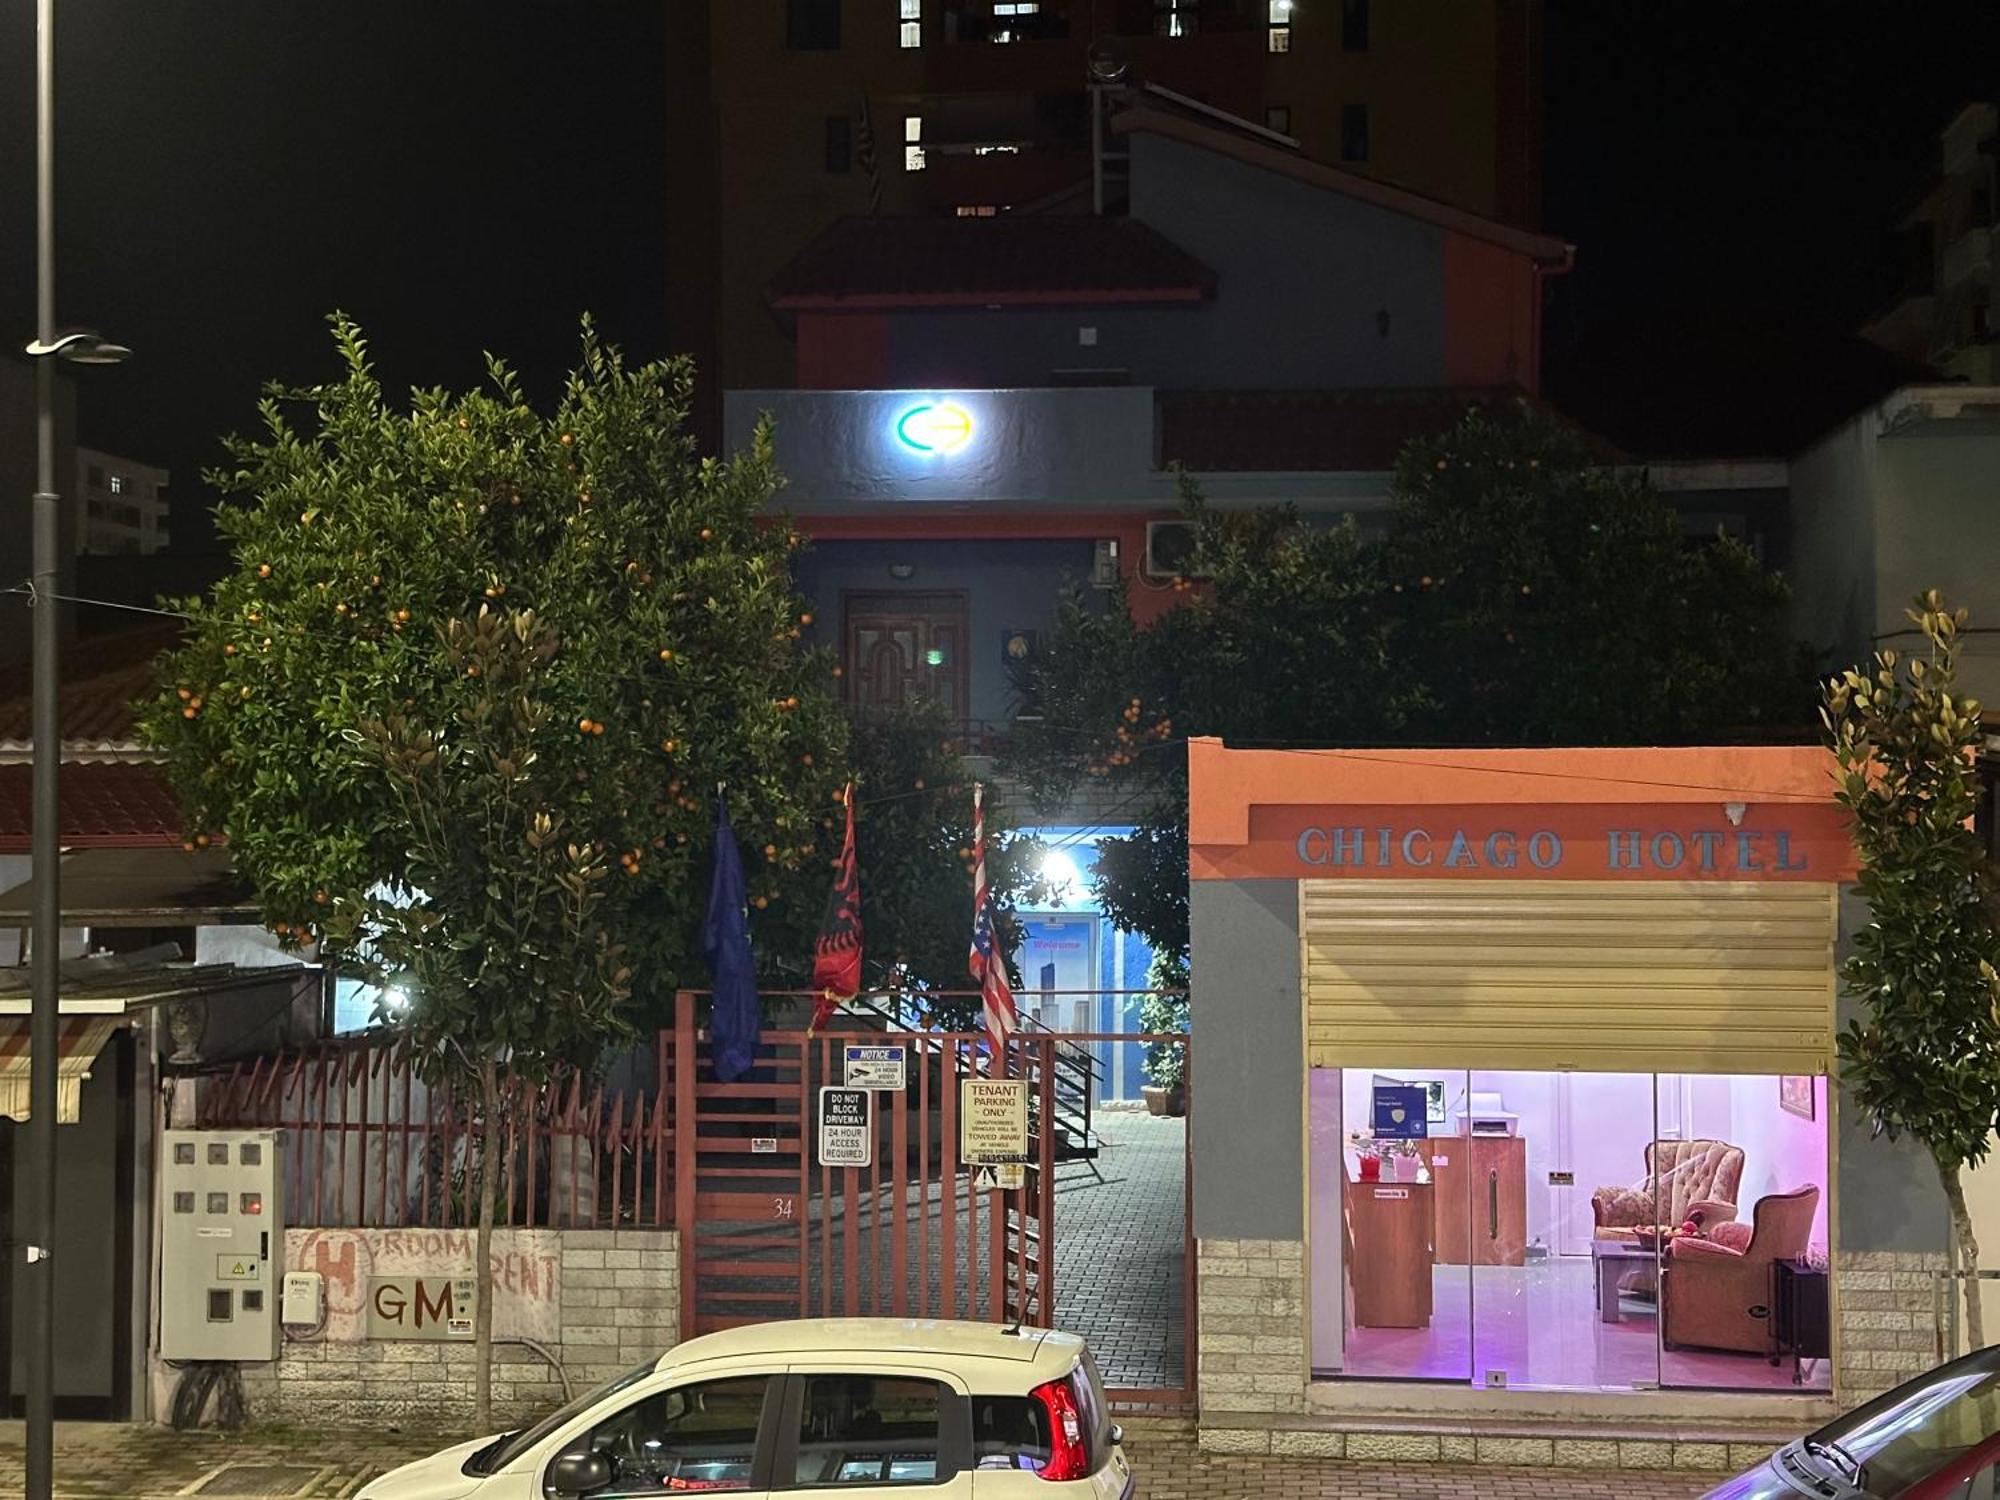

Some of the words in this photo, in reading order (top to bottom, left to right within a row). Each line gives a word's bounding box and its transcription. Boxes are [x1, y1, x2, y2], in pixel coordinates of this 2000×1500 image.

[1297, 826, 1563, 868] CHICAGO
[1607, 831, 1807, 871] HOTEL
[860, 1050, 890, 1060] NOTICE
[971, 1085, 1018, 1096] TENANT
[831, 1094, 843, 1104] DO
[844, 1094, 859, 1104] NOT
[974, 1097, 1016, 1107] PARKING
[833, 1105, 858, 1114] BLOCK
[982, 1108, 1006, 1117] ONLY
[826, 1115, 864, 1125] DRIVEWAY
[828, 1129, 838, 1137] 24
[840, 1129, 862, 1137] HOUR
[830, 1140, 860, 1148] ACCESS
[826, 1149, 864, 1158] REQUIRED
[773, 1198, 793, 1219] 34
[384, 1232, 470, 1259] ROOM
[375, 1279, 454, 1329] GM
